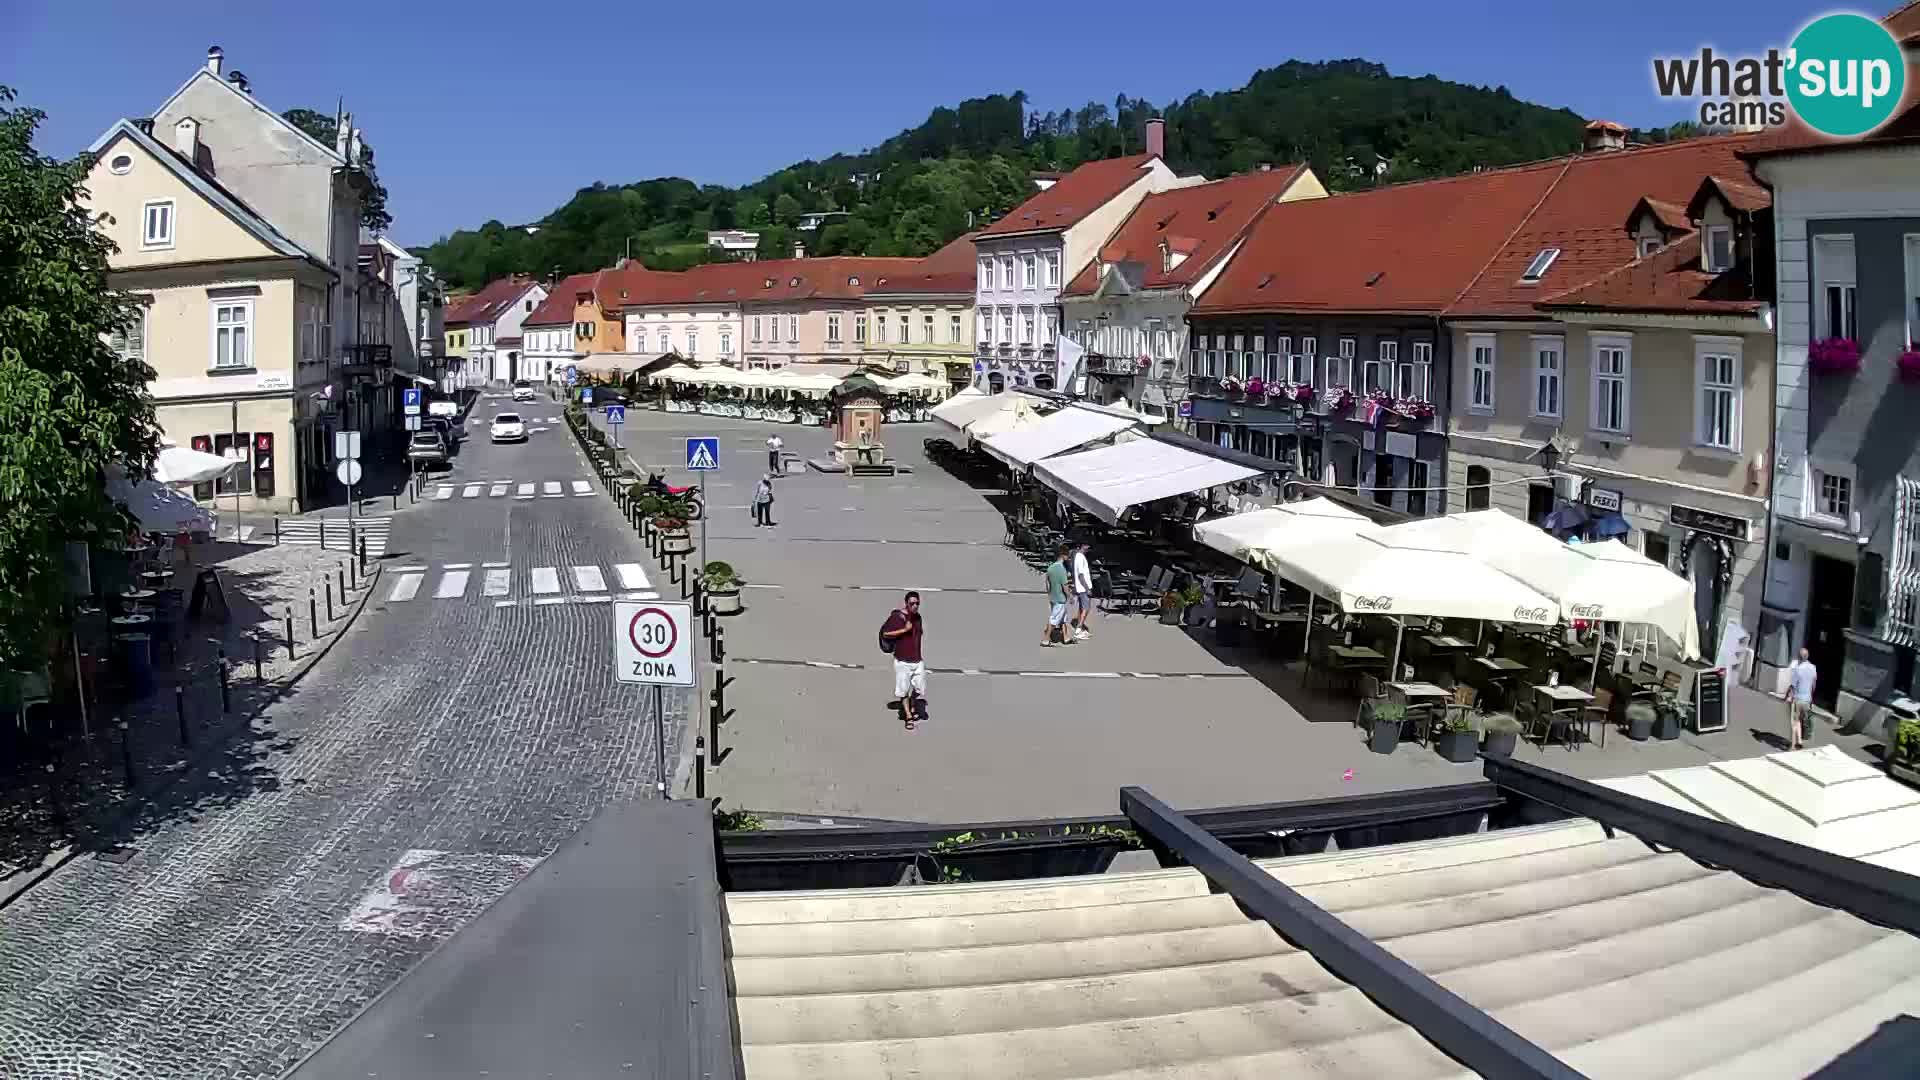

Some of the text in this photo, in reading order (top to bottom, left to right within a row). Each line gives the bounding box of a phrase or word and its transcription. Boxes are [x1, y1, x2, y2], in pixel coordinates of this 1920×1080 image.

[408, 392, 416, 404] P
[642, 623, 666, 645] 30
[632, 660, 677, 678] ZONA
